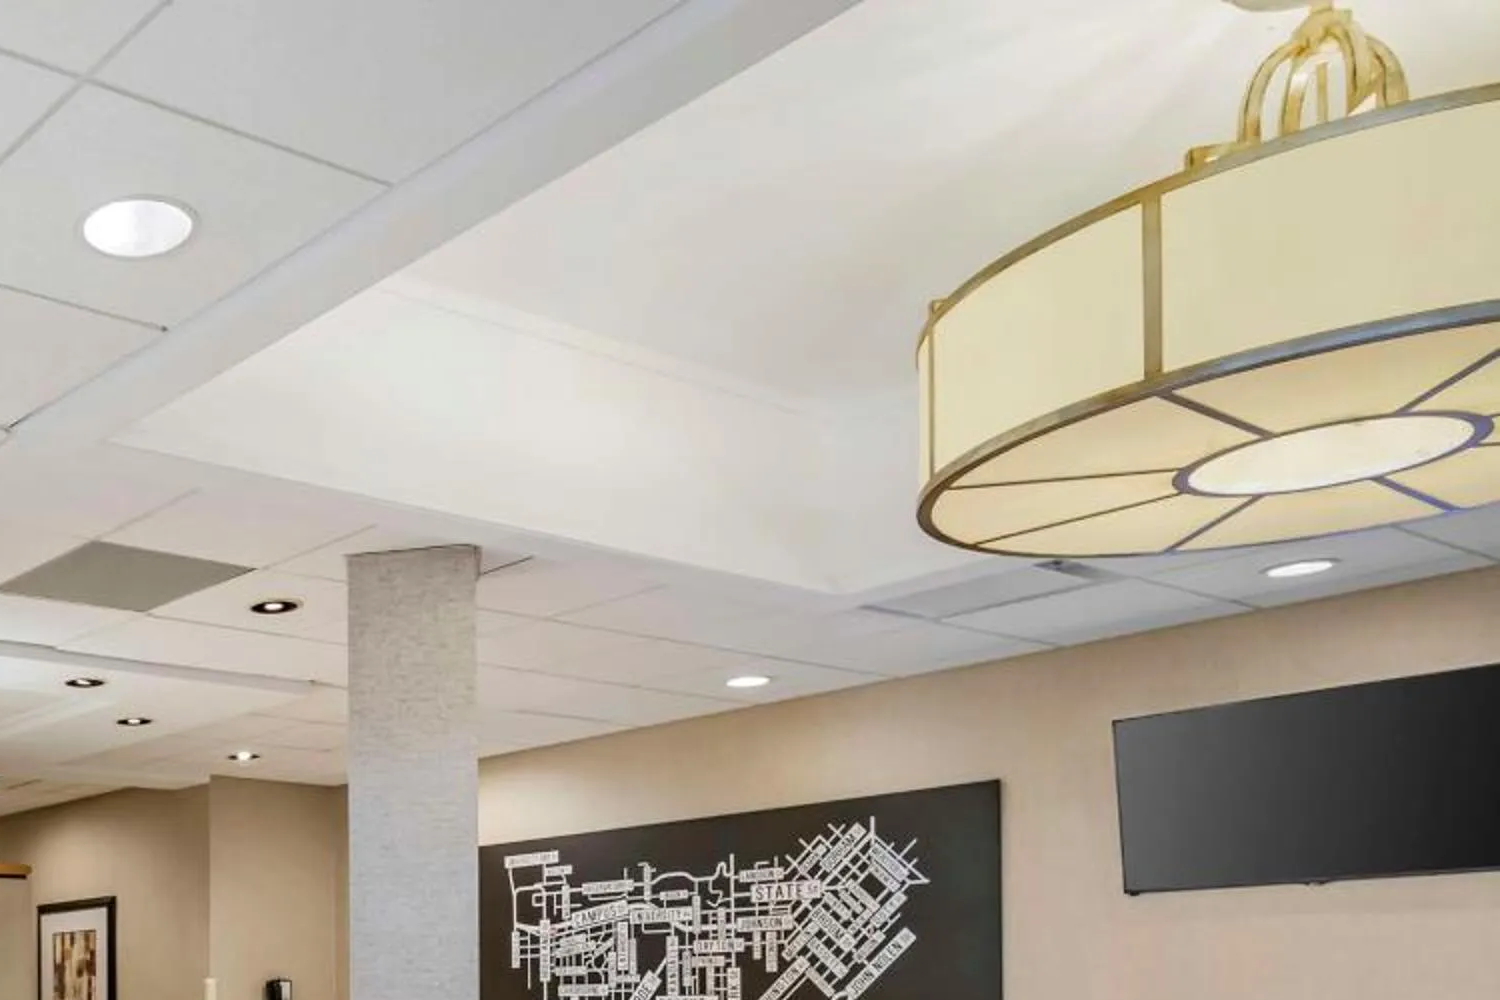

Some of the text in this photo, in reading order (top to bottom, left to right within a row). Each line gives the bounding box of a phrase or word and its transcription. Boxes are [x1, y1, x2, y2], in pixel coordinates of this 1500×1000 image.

[755, 884, 802, 900] STATE
[849, 968, 874, 993] JOHN
[870, 939, 903, 972] NOLEN
